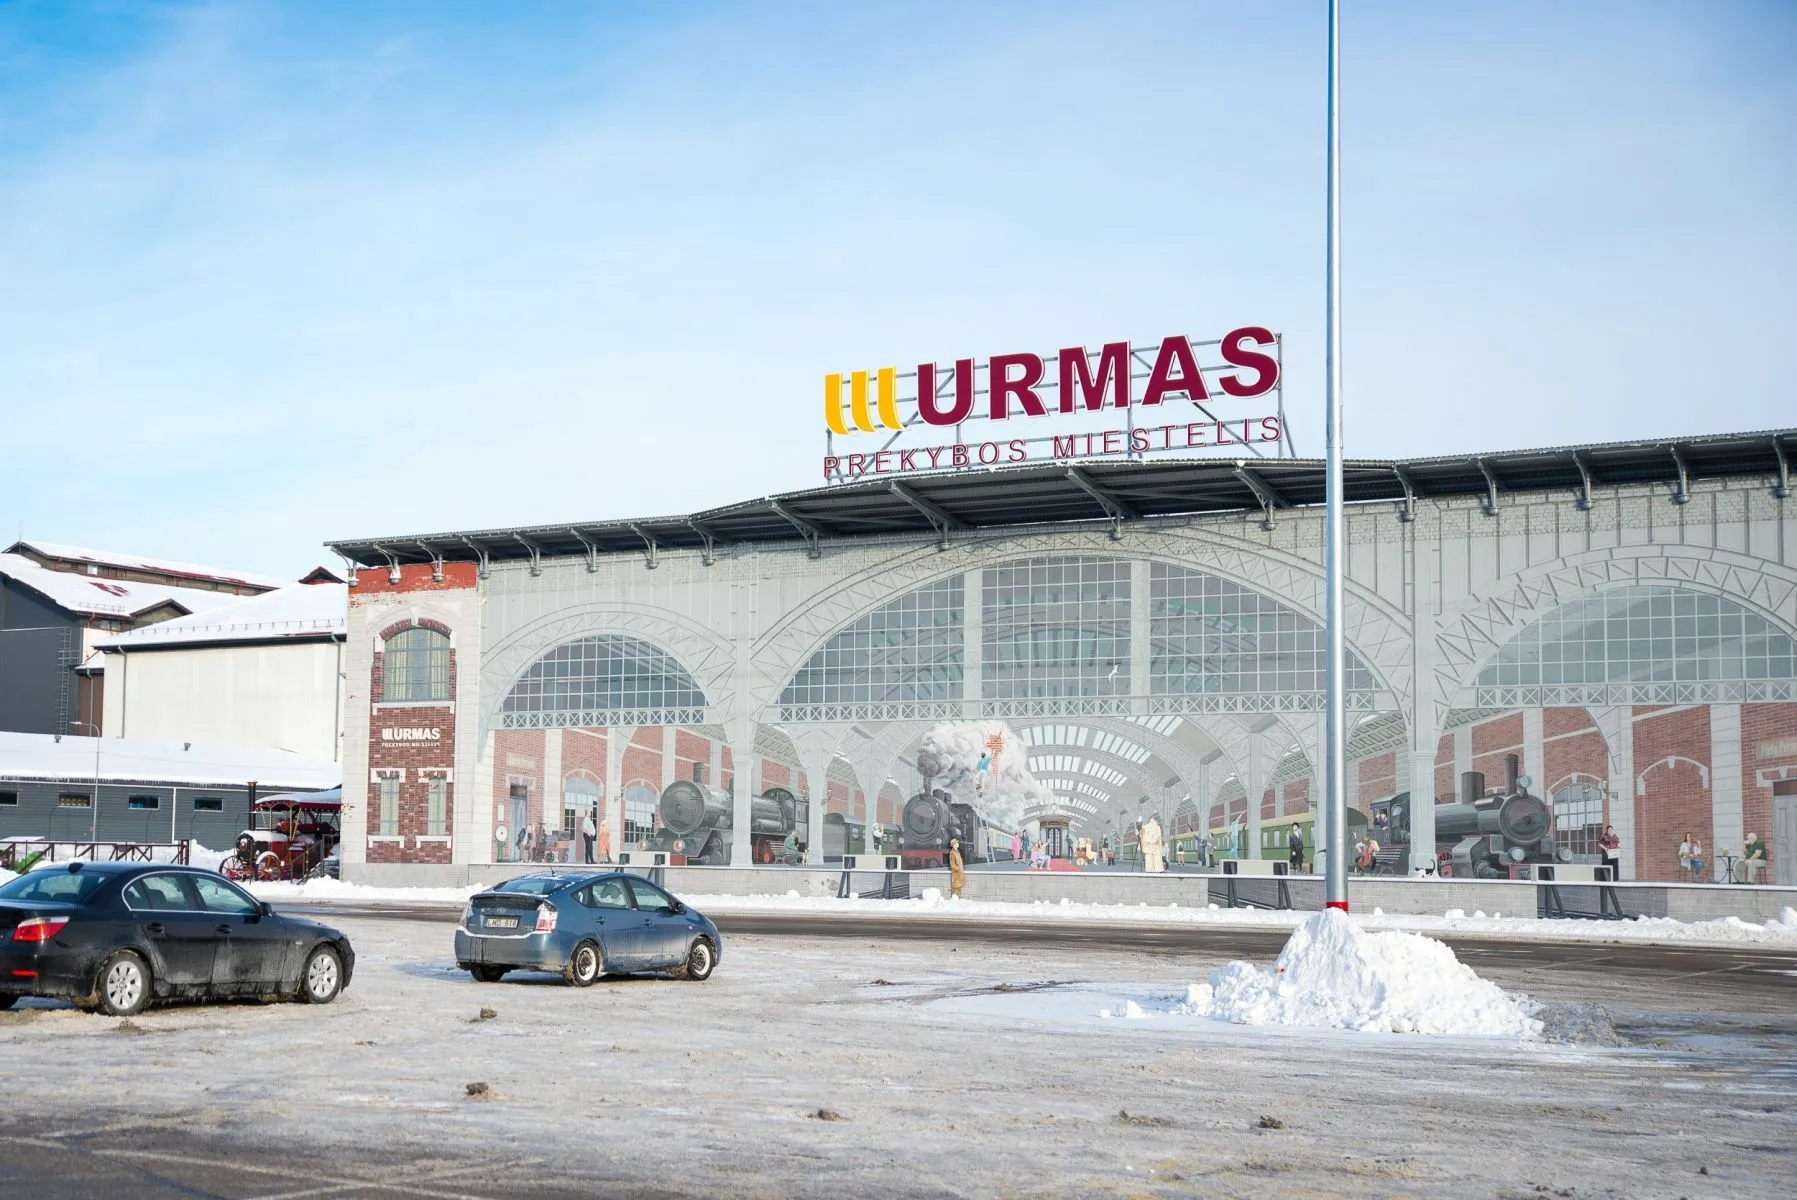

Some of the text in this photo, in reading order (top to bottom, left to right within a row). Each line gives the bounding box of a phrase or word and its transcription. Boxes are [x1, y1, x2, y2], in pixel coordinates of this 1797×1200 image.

[917, 326, 1281, 427] URMAS
[823, 416, 1281, 480] PREKYBOS MIESTELIS
[393, 727, 441, 740] URMAS
